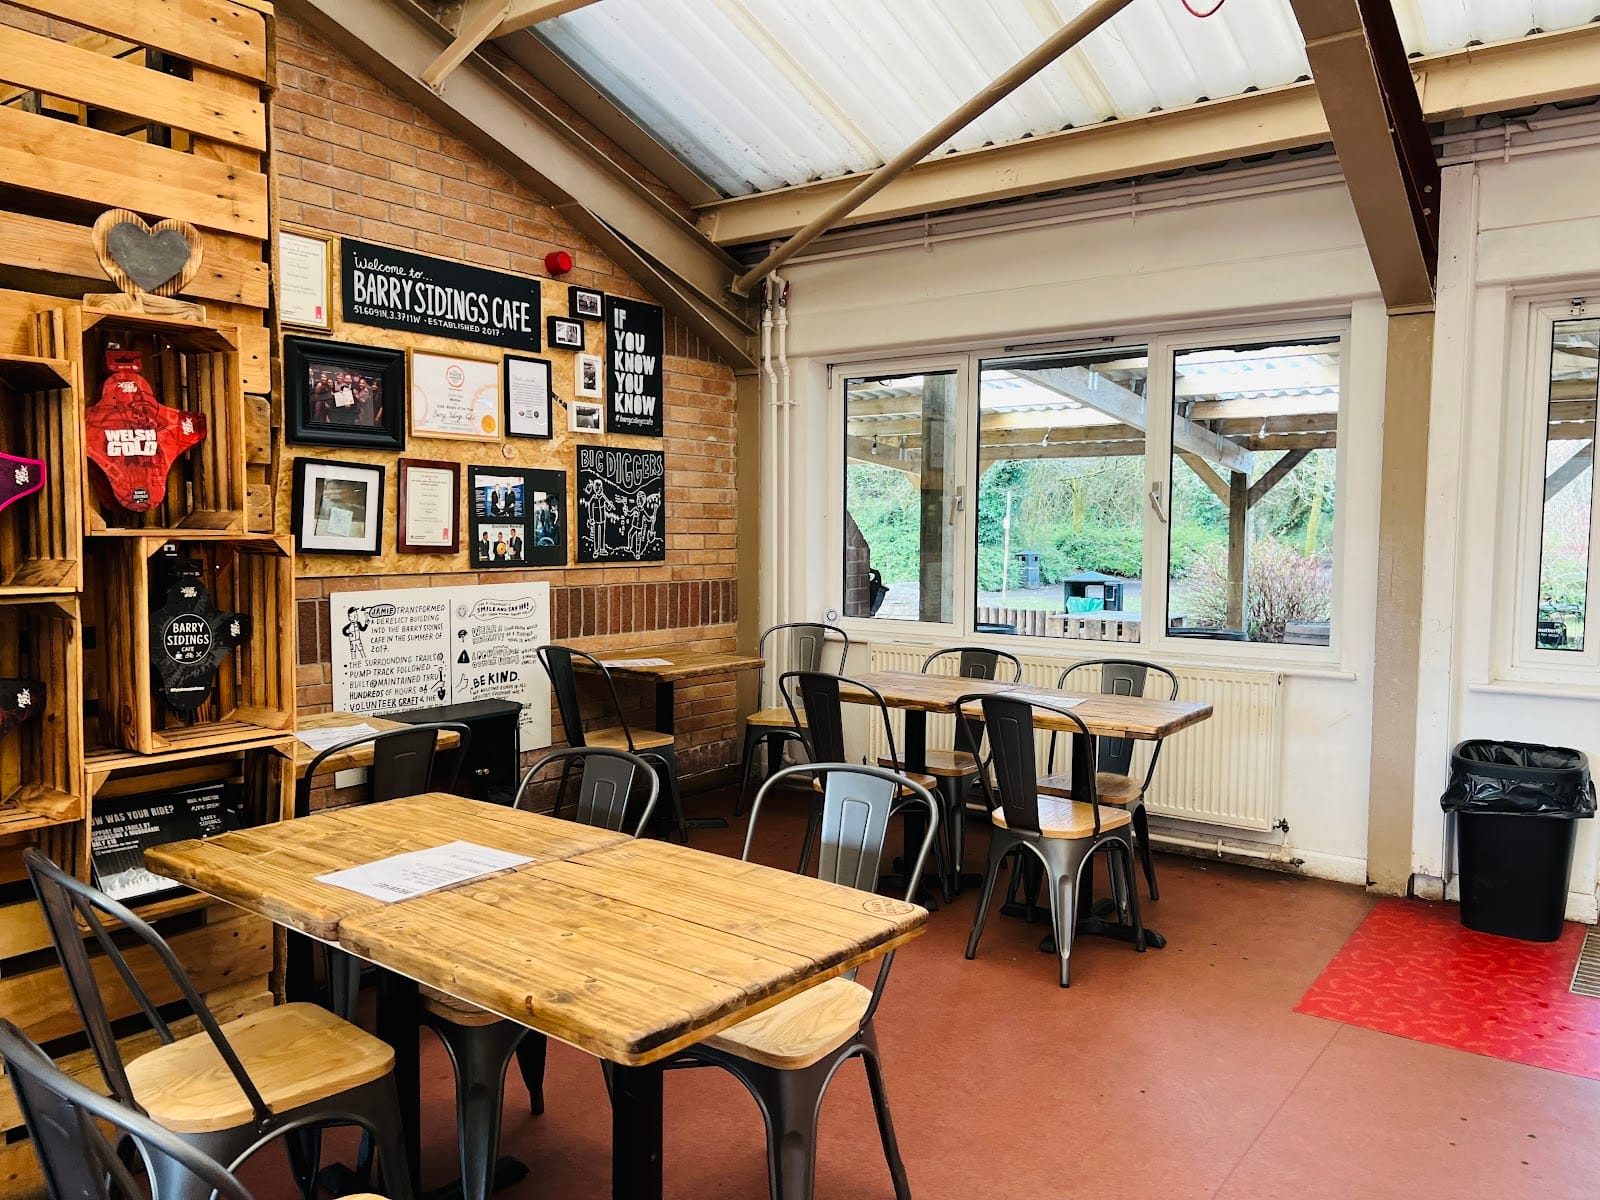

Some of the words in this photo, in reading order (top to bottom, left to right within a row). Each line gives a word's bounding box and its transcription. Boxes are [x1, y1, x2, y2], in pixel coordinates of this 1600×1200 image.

[353, 251, 407, 276] Welcome
[353, 269, 414, 311] BARRY
[413, 281, 490, 325] SIDINGS
[491, 296, 532, 333] CAFE
[614, 307, 627, 330] IF
[427, 317, 481, 334] ESTABLISHED
[481, 327, 501, 337] 2017
[614, 330, 646, 354] YOU
[614, 350, 656, 376] KNOW
[614, 371, 644, 395] YOU
[614, 391, 656, 417] KNOW
[104, 429, 157, 442] WELSH
[107, 440, 158, 456] GOLD
[581, 449, 604, 473] BIG
[606, 451, 664, 489] DIGGERS
[371, 607, 394, 615] JAMIE
[397, 604, 446, 614] TRANSFORMED
[477, 605, 496, 614] SMILE
[376, 616, 408, 625] DERELICT
[409, 614, 440, 623] BUILDING
[388, 625, 400, 633] THE
[401, 624, 423, 633] BARRY
[423, 622, 444, 632] SIDINGS
[172, 622, 204, 634] BARRY
[167, 634, 210, 646] SIDINGS
[370, 636, 385, 644] CAFE
[407, 633, 434, 642] SUMMER
[434, 632, 443, 640] OF
[349, 660, 362, 669] THE
[364, 656, 413, 667] SURROUNDING
[415, 653, 437, 662] TRAILS
[349, 669, 372, 679] PUMP
[373, 667, 395, 676] TRACK
[396, 663, 431, 674] FOLLOWED
[349, 680, 369, 689] BUILT
[378, 675, 421, 687] MAINTAINED
[422, 673, 439, 681] THRU
[473, 674, 486, 689] BE
[488, 670, 520, 686] KIND.
[349, 689, 384, 700] HUNDREDS
[384, 688, 393, 696] OF
[394, 687, 417, 695] HOURS
[349, 698, 396, 711] VOLUNTEER
[398, 697, 418, 706] GRAFT
[426, 694, 437, 702] THE
[92, 816, 104, 827] OW
[105, 812, 126, 825] WAS
[127, 808, 150, 822] YOUR
[150, 804, 176, 817] RIDE?
